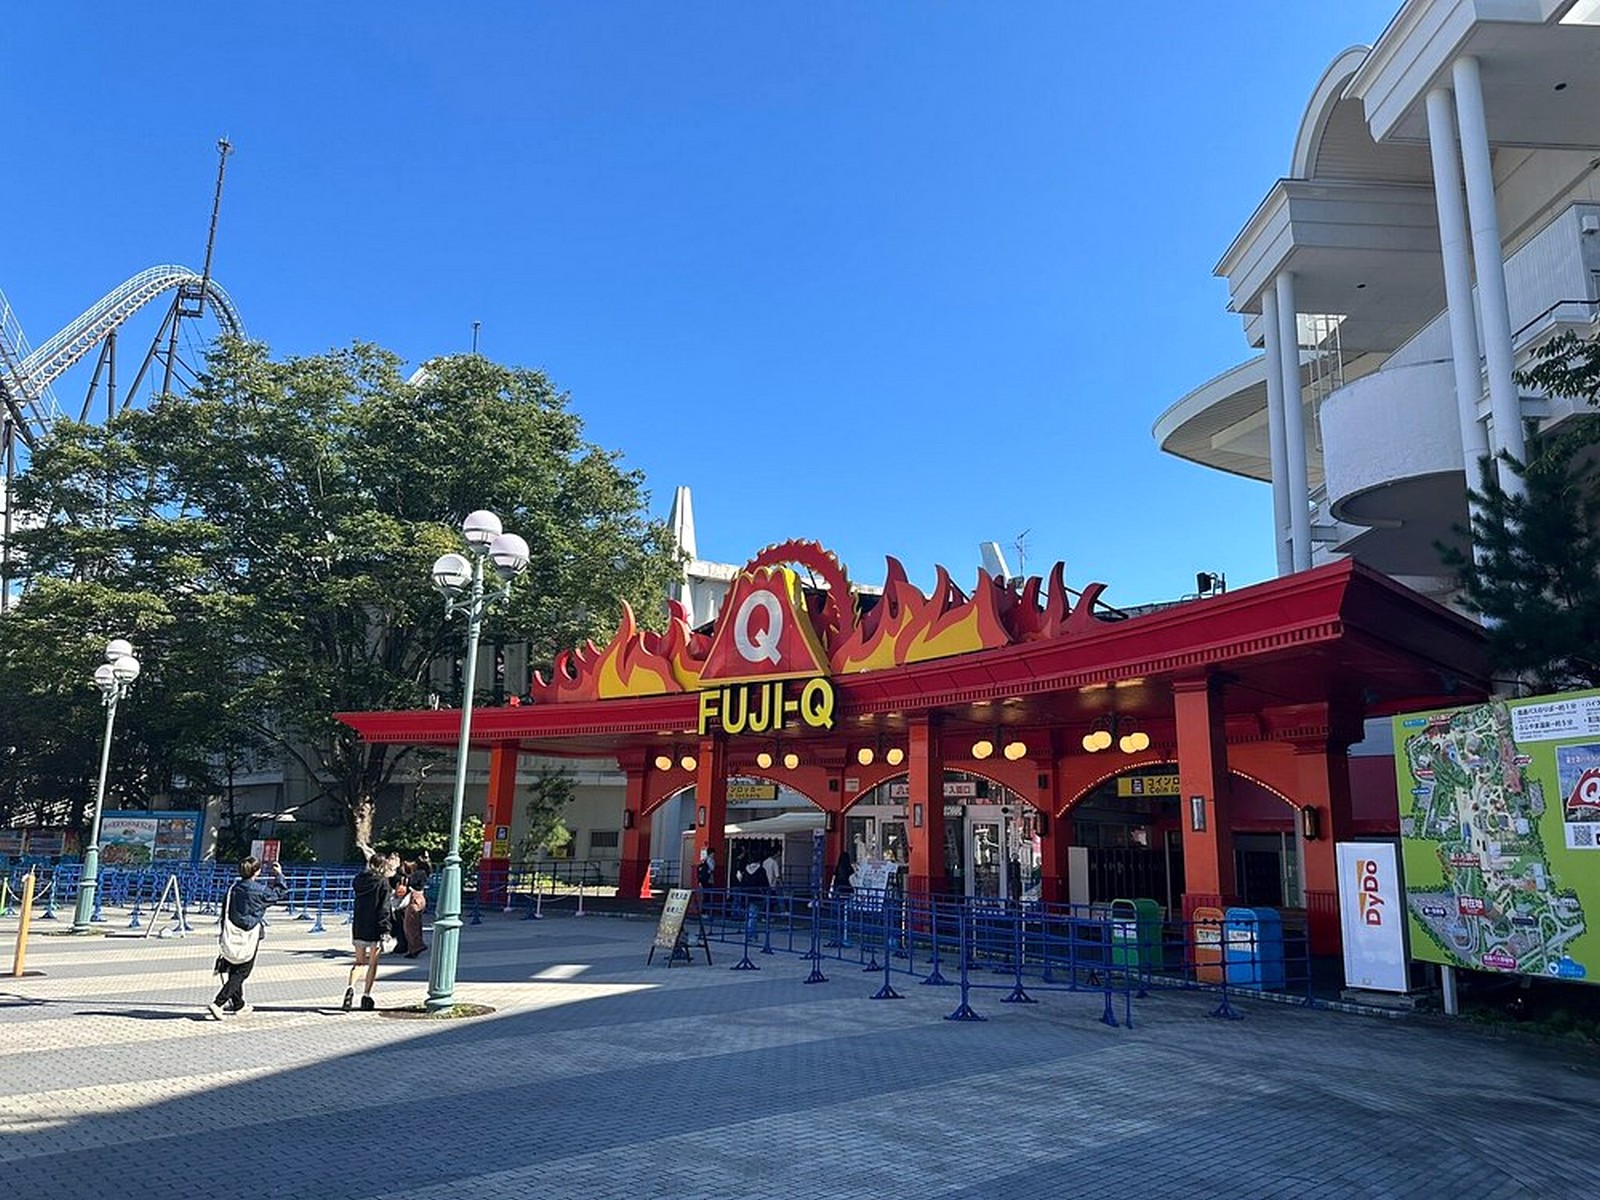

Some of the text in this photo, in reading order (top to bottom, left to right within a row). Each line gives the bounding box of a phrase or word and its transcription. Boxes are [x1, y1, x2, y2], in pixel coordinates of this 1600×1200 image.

[734, 590, 783, 666] Q
[698, 678, 834, 735] FUJI-Q
[1364, 860, 1385, 926] DyDo
[1460, 897, 1484, 910] 現在地
